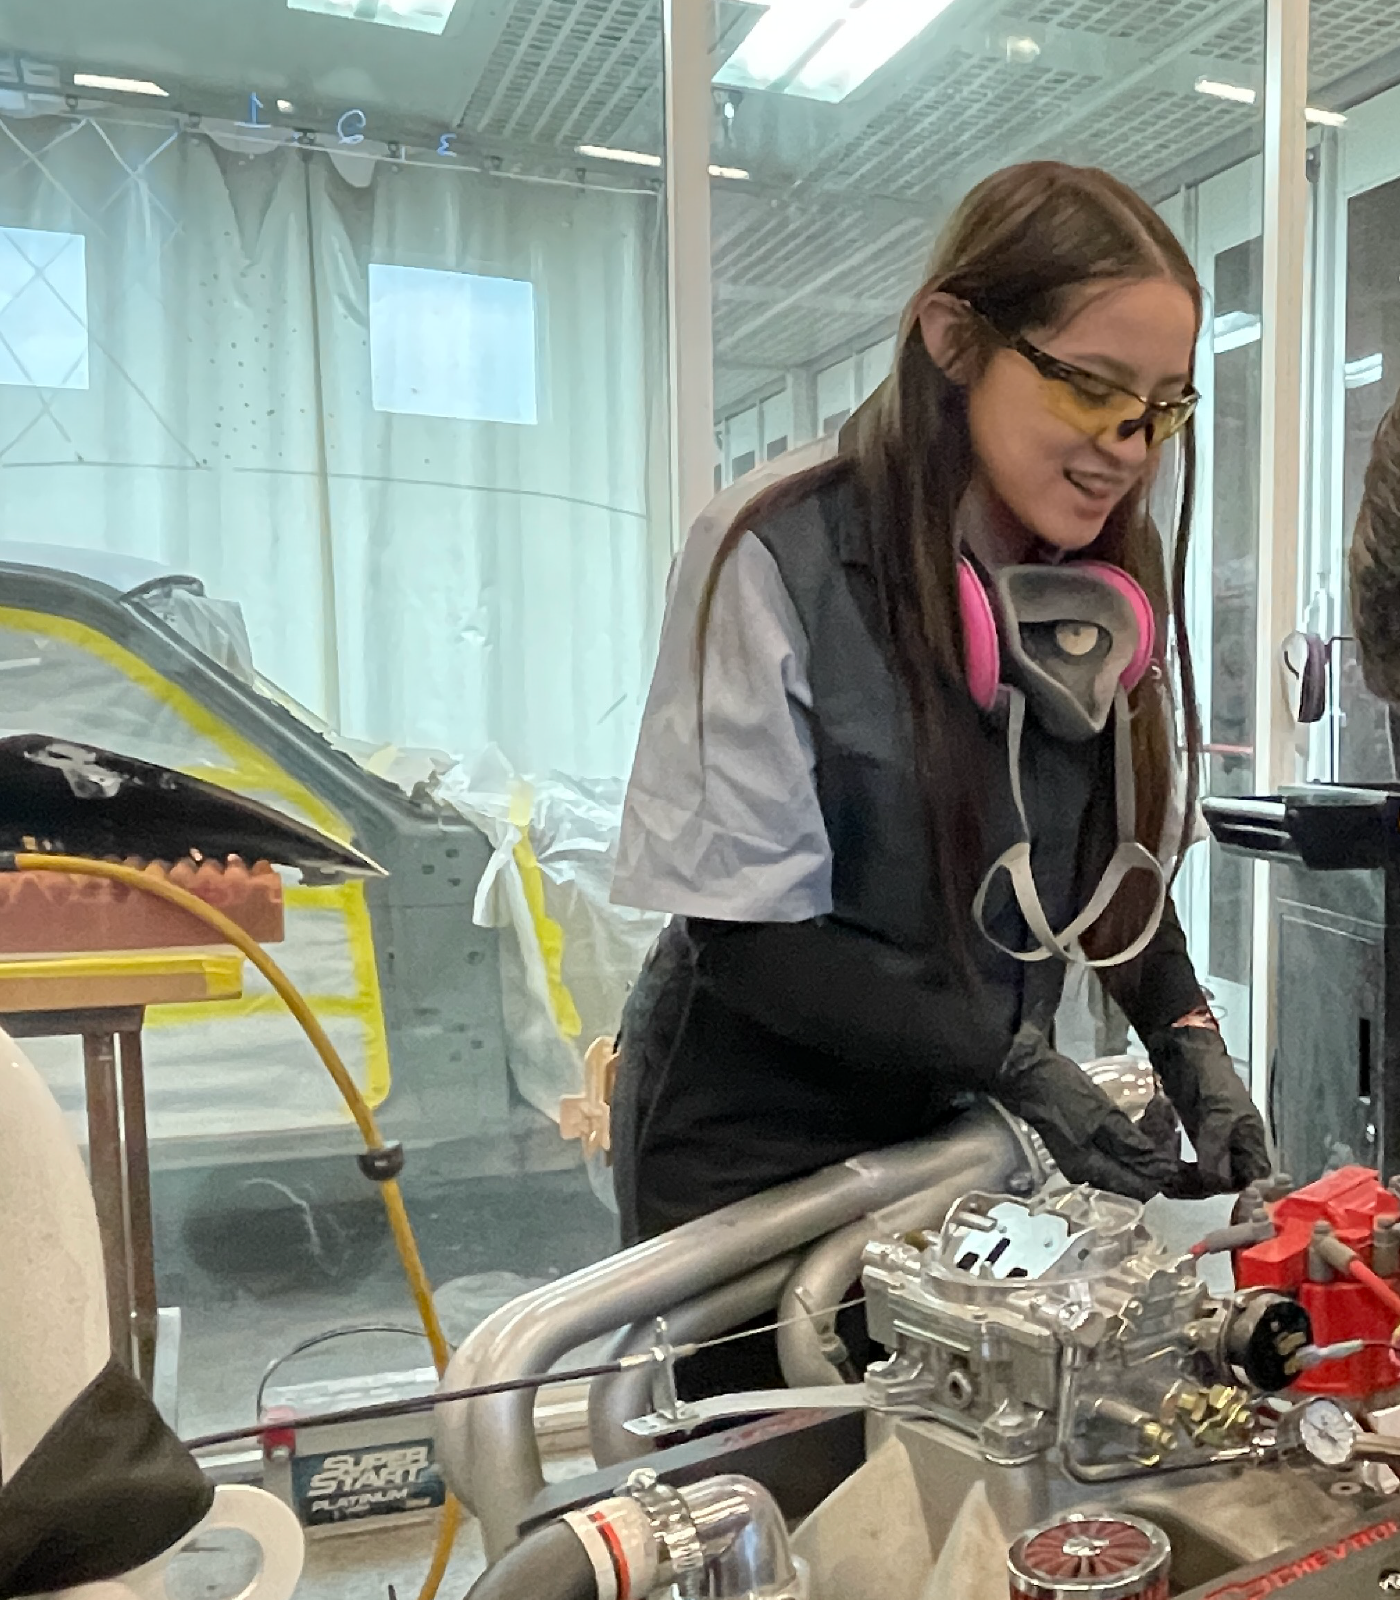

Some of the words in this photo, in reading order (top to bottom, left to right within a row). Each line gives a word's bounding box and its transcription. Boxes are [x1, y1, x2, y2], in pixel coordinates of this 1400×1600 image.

[323, 1446, 428, 1476] SUPER
[307, 1461, 428, 1497] START
[311, 1488, 408, 1512] PLATINUM
